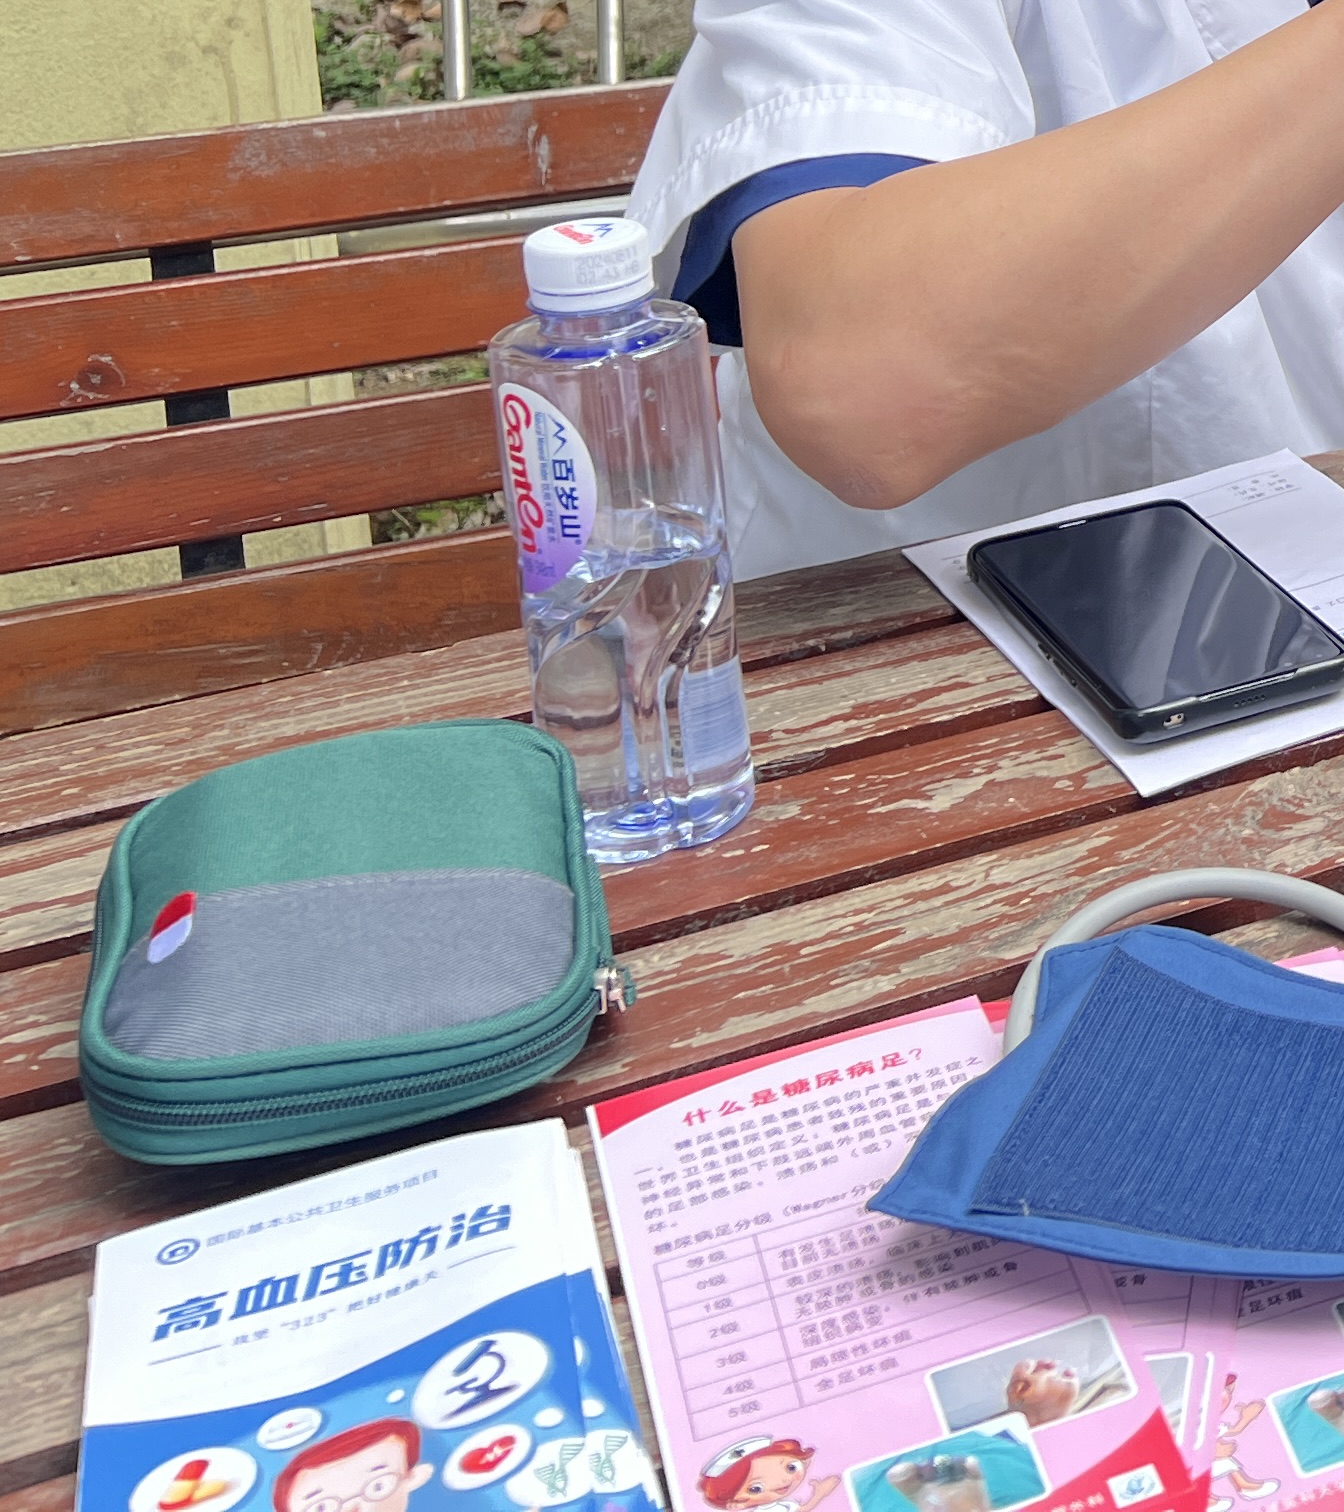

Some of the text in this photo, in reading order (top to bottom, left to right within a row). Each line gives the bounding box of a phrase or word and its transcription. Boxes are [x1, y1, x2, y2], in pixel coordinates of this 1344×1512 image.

[552, 458, 581, 539] 百岁山
[151, 1204, 512, 1342] 高血压防治
[704, 1297, 733, 1313] 1级
[709, 1321, 740, 1339] 2级
[716, 1350, 748, 1368] 3级
[723, 1378, 755, 1395] 4级
[728, 1400, 761, 1418] 5级
